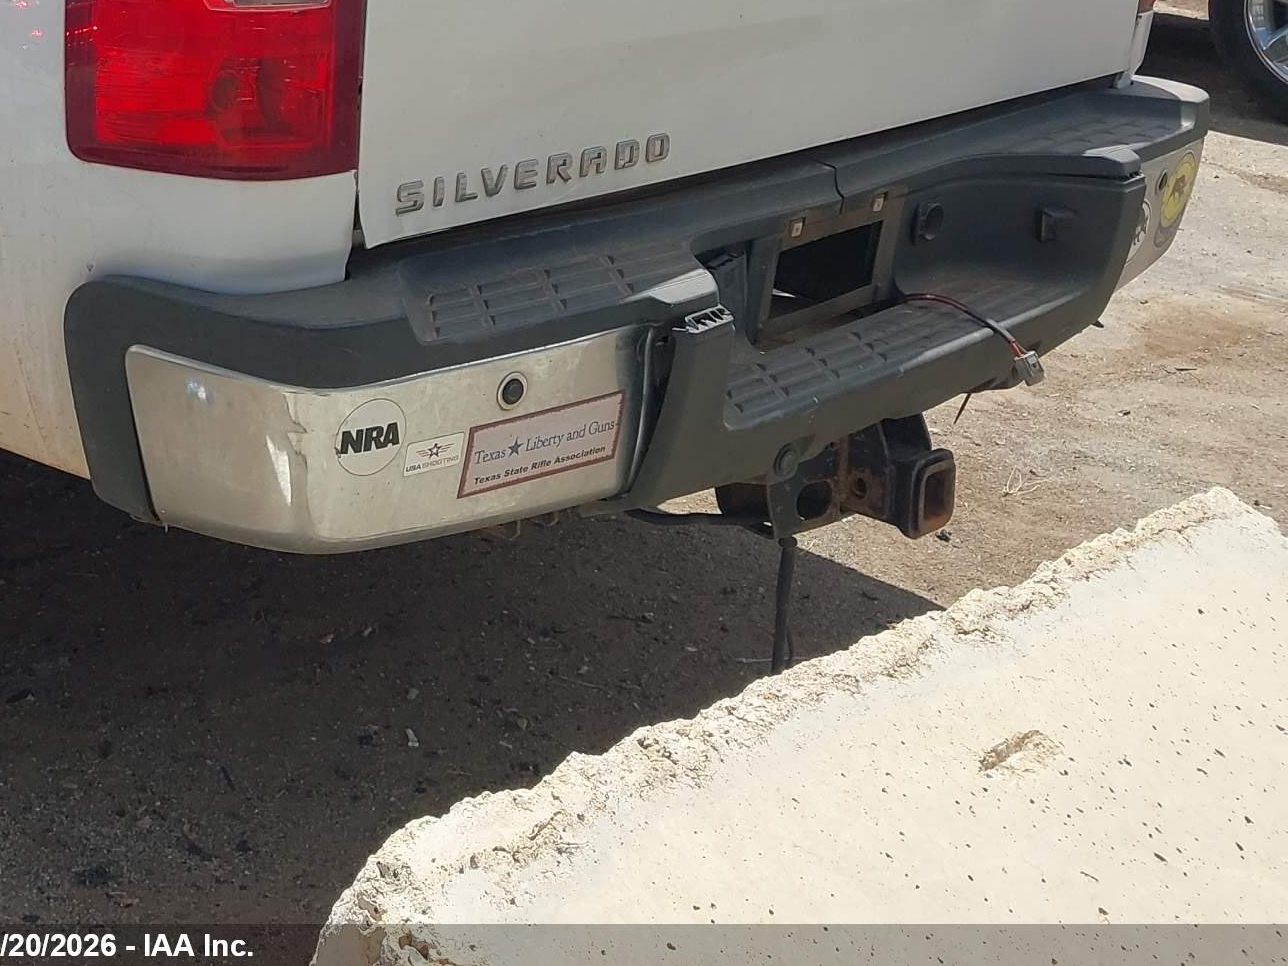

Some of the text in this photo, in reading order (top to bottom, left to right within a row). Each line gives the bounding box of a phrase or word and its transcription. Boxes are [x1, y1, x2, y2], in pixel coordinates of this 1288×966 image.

[396, 132, 671, 216] SILVERADO
[339, 422, 400, 455] NRA
[474, 420, 615, 465] Texas Liberty and Guns
[405, 464, 422, 473] USA
[473, 446, 606, 485] Texas State Rifle Association
